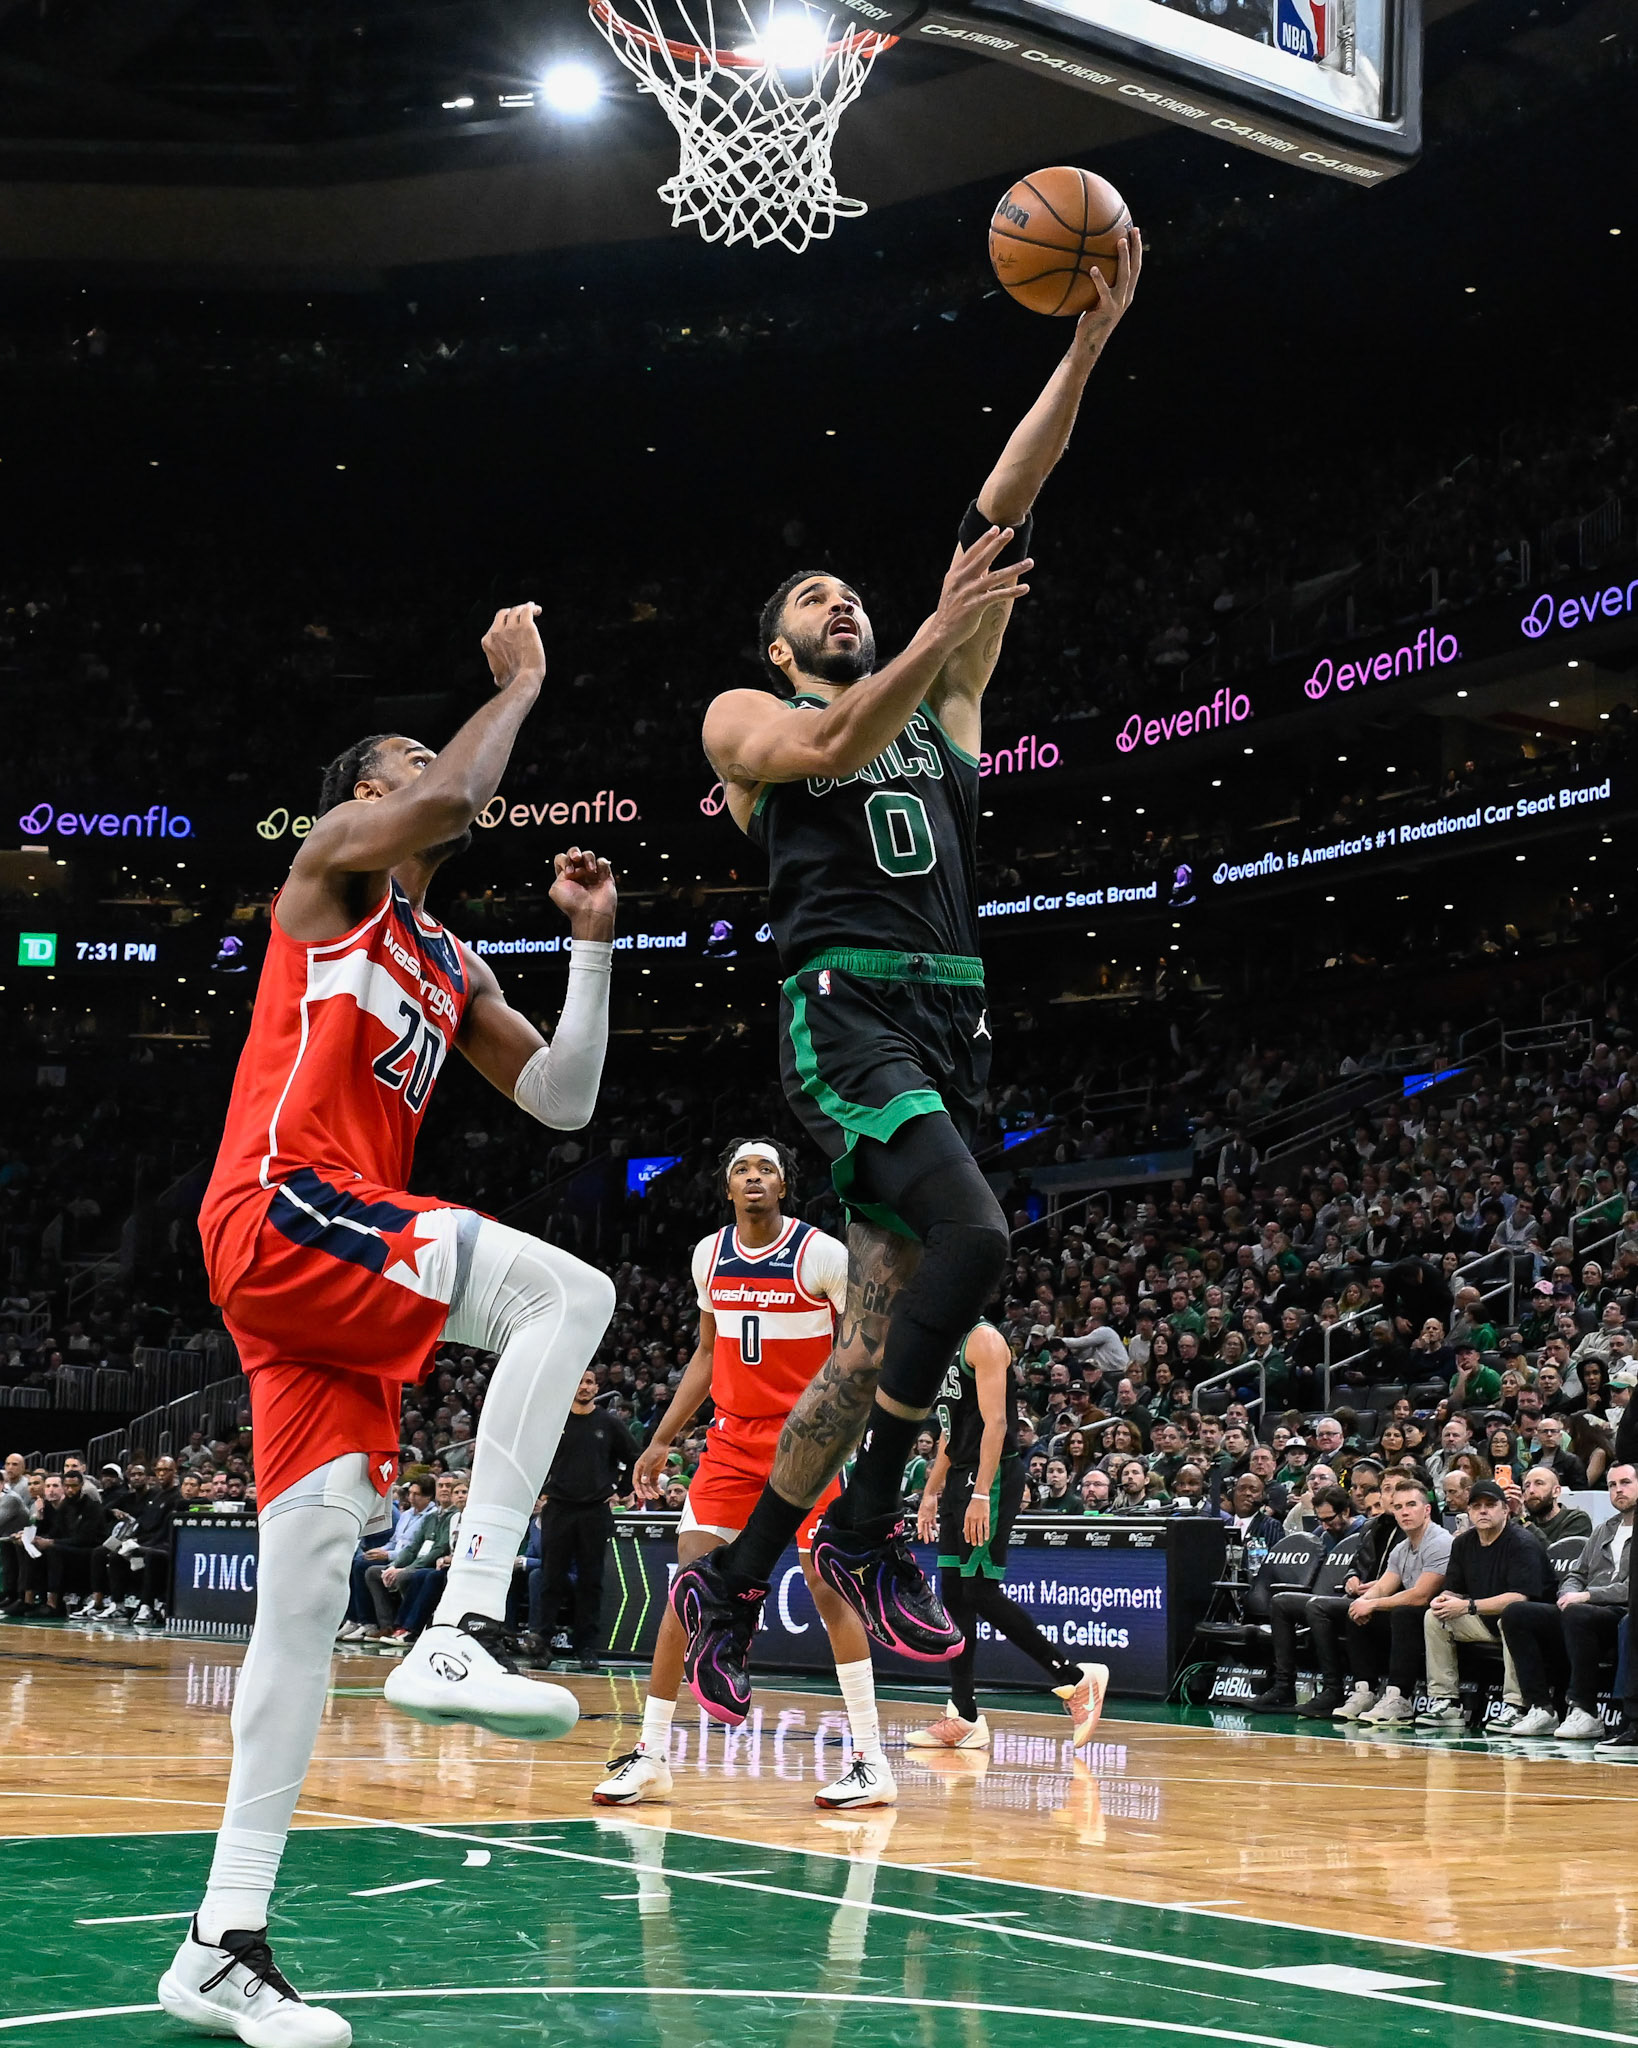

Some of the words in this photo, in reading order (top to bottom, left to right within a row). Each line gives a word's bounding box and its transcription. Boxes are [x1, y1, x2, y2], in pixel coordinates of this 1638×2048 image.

[840, 0, 893, 20] ERGY
[919, 24, 967, 37] C4
[963, 32, 1019, 51] ENERGY
[1282, 22, 1308, 54] NBA
[1021, 50, 1064, 69] C4
[1061, 64, 1117, 85] ENERGY
[1118, 84, 1163, 103] C4
[1156, 97, 1210, 120] ENERGY
[1210, 118, 1254, 137] C4
[1247, 131, 1299, 153] ENERGY
[1298, 152, 1341, 169] C4
[1336, 163, 1384, 180] ENERGY
[997, 191, 1031, 230] lson
[1558, 579, 1638, 628] even
[1336, 627, 1458, 691] evenflo
[1144, 687, 1250, 745] evenflo
[979, 735, 1060, 777] enflo
[56, 805, 191, 838] evenflo
[509, 790, 638, 827] evenflo
[864, 791, 937, 877] 0
[1228, 852, 1283, 882] evenflo
[1287, 852, 1299, 868] is
[1375, 828, 1396, 848] #1
[1400, 808, 1481, 843] Rotational
[1484, 805, 1514, 824] Car
[1517, 793, 1555, 818] Seat
[1559, 778, 1611, 808] Brand
[978, 895, 1031, 917] ational
[1033, 895, 1063, 911] Car
[1065, 889, 1104, 908] Seat
[1107, 881, 1157, 903] Brand
[23, 939, 53, 960] TD
[76, 942, 118, 960] 7:31
[124, 943, 157, 962] PM
[476, 936, 560, 954] Rotational
[637, 931, 687, 949] Brand
[383, 928, 458, 1032] wasngton
[372, 999, 447, 1114] 20
[711, 1284, 796, 1308] washington
[741, 1315, 762, 1365] 0
[193, 1553, 255, 1592] PIMC
[1265, 1552, 1310, 1564] PIMCO
[1326, 1553, 1354, 1565] PIM
[1040, 1580, 1162, 1613] Management
[1063, 1620, 1129, 1648] Celtics
